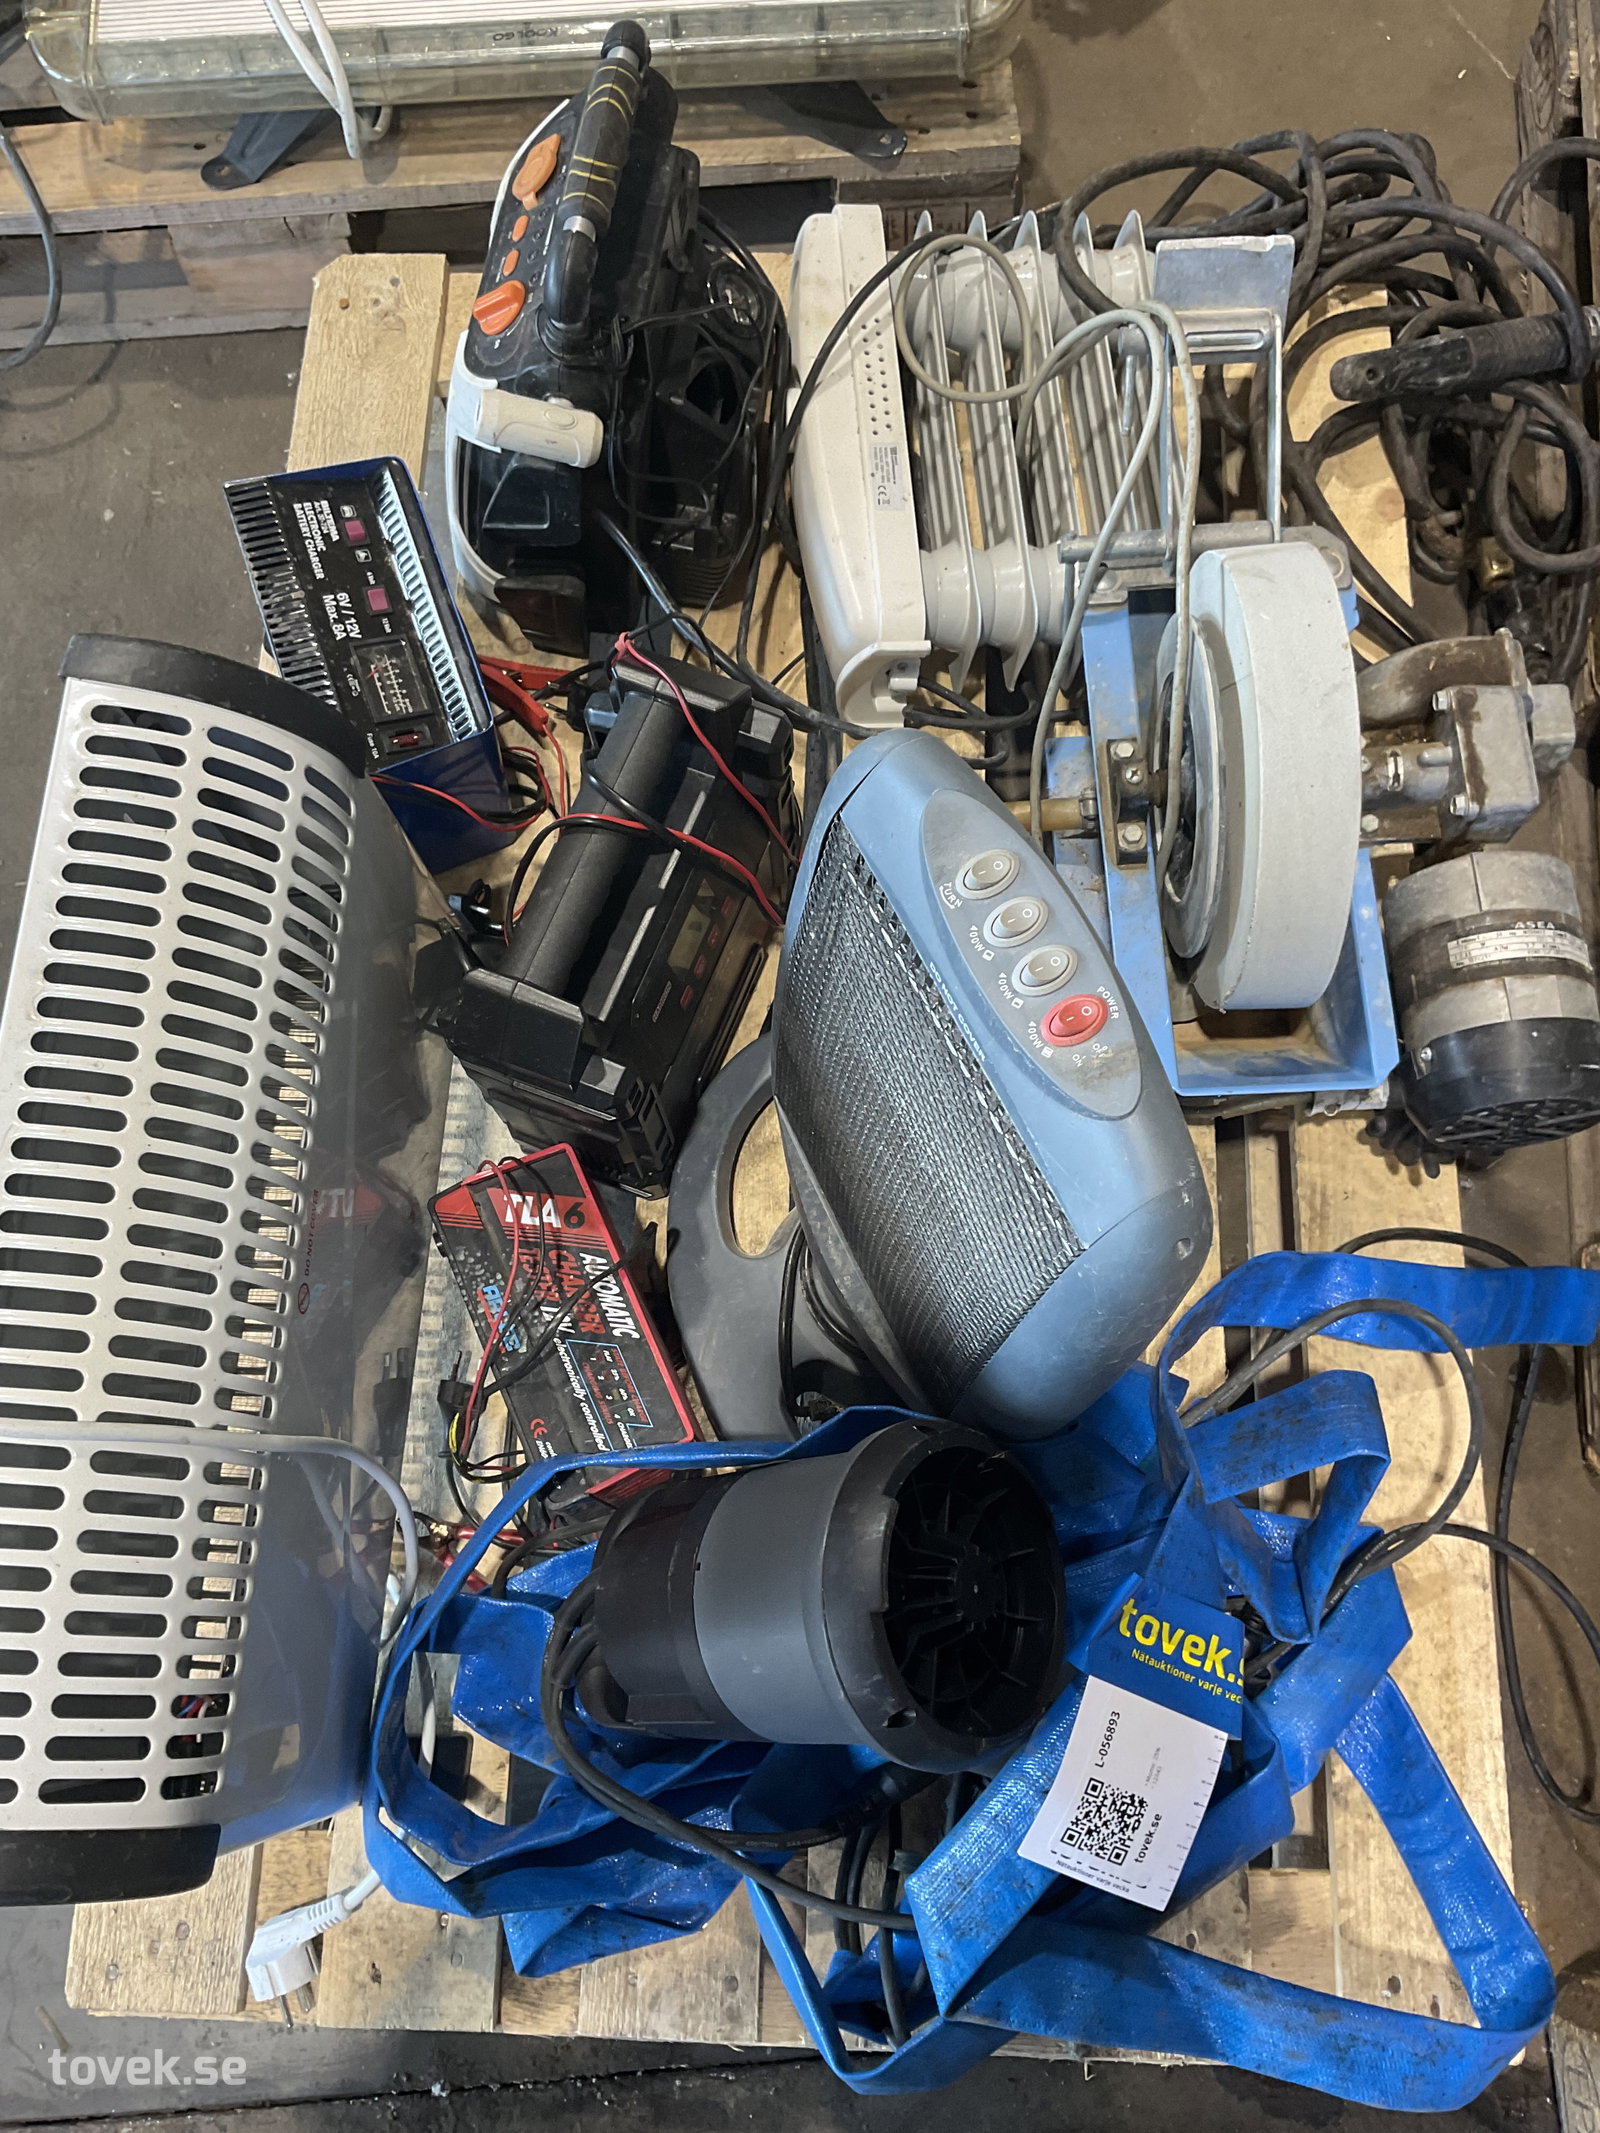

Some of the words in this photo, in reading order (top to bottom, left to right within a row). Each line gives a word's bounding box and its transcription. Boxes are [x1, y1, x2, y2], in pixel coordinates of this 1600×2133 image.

[292, 503, 311, 537] BATTERY
[304, 539, 324, 579] CHARGER
[302, 502, 326, 552] ELECTRONIC
[320, 500, 340, 542] BILTEMA
[321, 595, 341, 622] Max.
[331, 623, 347, 640] 8A
[336, 592, 352, 609] 6V
[343, 617, 361, 637] 12V
[366, 732, 375, 747] Fuse
[370, 746, 379, 759] 10A
[943, 881, 963, 908] TURN
[969, 924, 985, 952] 400W
[1514, 921, 1555, 929] ASEA
[998, 971, 1014, 999] 400W
[1096, 985, 1119, 1018] POWER
[929, 961, 943, 983] DO
[940, 982, 958, 1010] NOT
[957, 1013, 986, 1062] COVER
[1028, 1020, 1043, 1048] 400W
[304, 1259, 311, 1276] DO
[309, 1188, 318, 1229] COVER
[578, 1253, 640, 1338] AUTOMATIC
[552, 1338, 589, 1399] electronically
[578, 1402, 610, 1452] controlled
[1132, 1648, 1195, 1683] Nätauktioner
[1198, 1677, 1222, 1696] varje
[1095, 1710, 1120, 1768] L-056893
[1134, 1814, 1162, 1864] tovek.se
